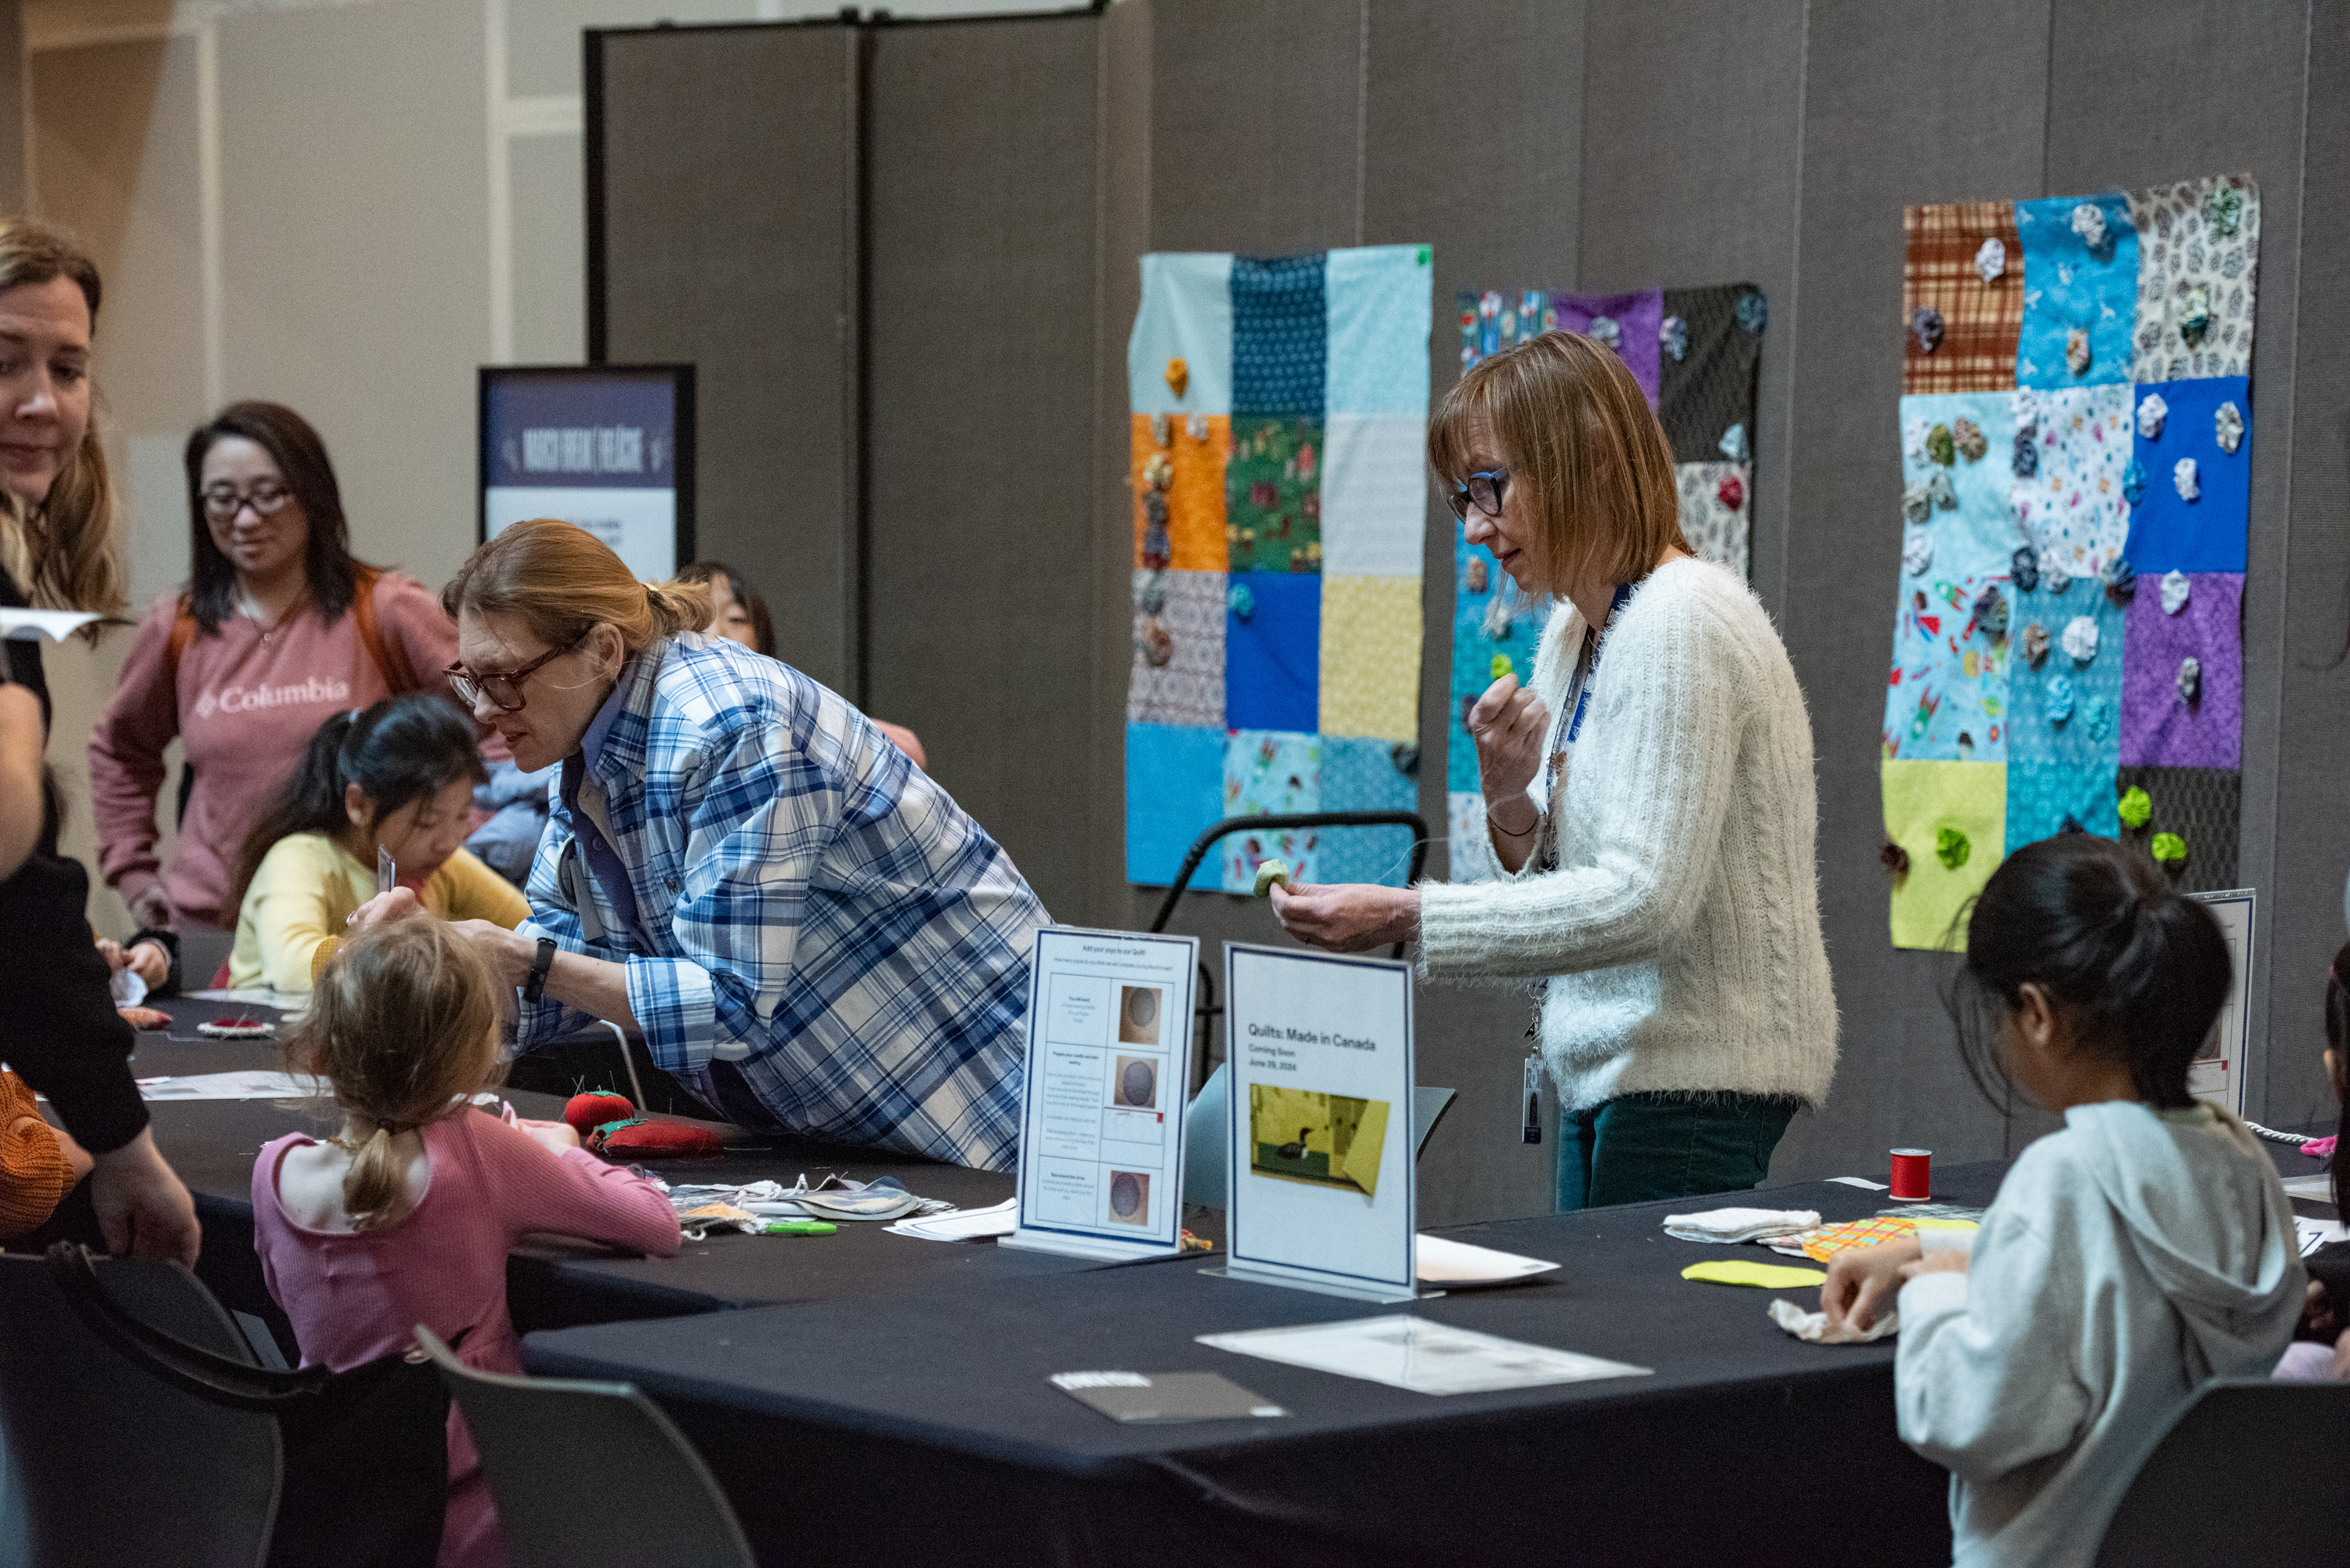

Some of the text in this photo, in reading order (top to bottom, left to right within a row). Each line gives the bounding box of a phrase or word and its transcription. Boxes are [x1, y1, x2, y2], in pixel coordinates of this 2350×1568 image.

[219, 676, 349, 714] Columbia
[1249, 1023, 1376, 1051] Quilts: Made in Canada
[1248, 1044, 1296, 1057] Coming Soon
[1249, 1059, 1266, 1068] June
